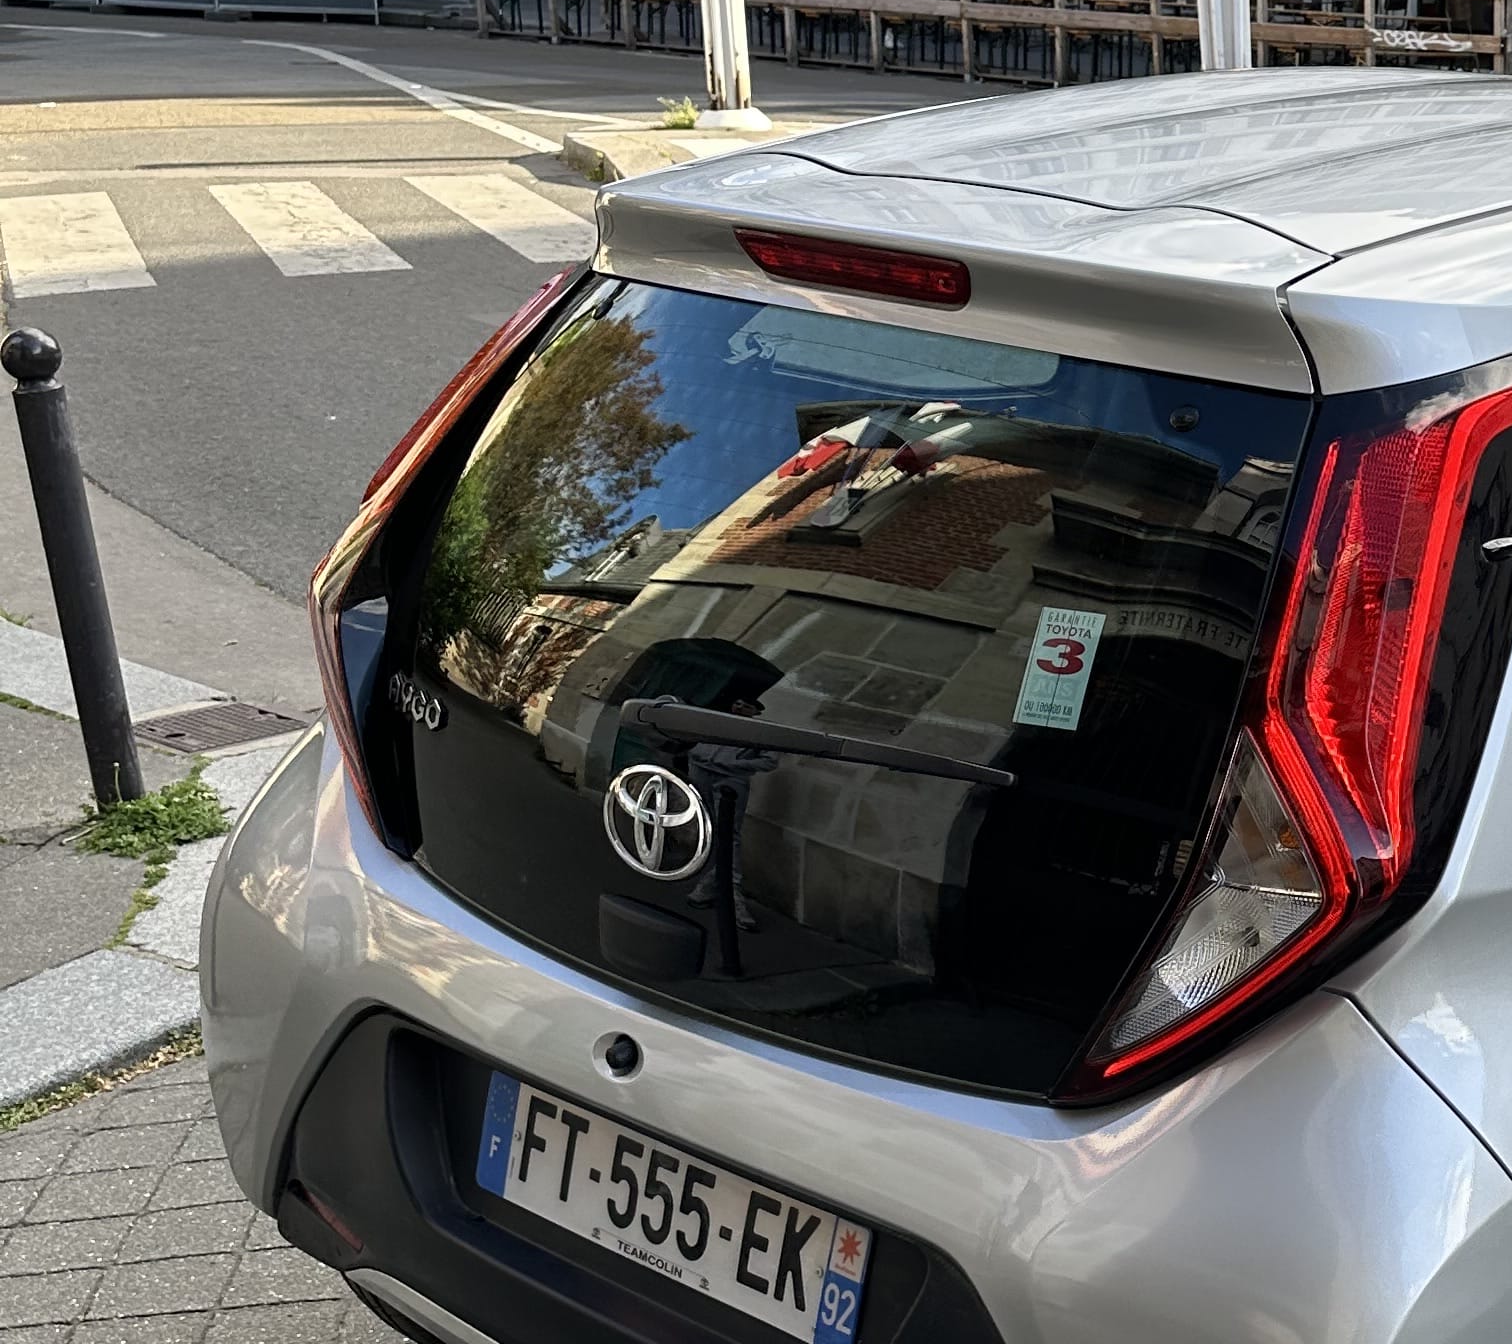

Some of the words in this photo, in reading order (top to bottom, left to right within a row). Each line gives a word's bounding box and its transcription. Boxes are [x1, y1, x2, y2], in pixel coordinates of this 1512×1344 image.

[1045, 624, 1092, 639] TOYOTA
[1047, 611, 1098, 628] GARANTIE
[1036, 638, 1086, 675] 3
[388, 670, 442, 730] AYGO
[489, 1135, 501, 1158] F
[518, 1094, 822, 1313] FT-555-EK
[616, 1239, 683, 1279] TEAMCOLIN
[821, 1282, 857, 1337] 92
